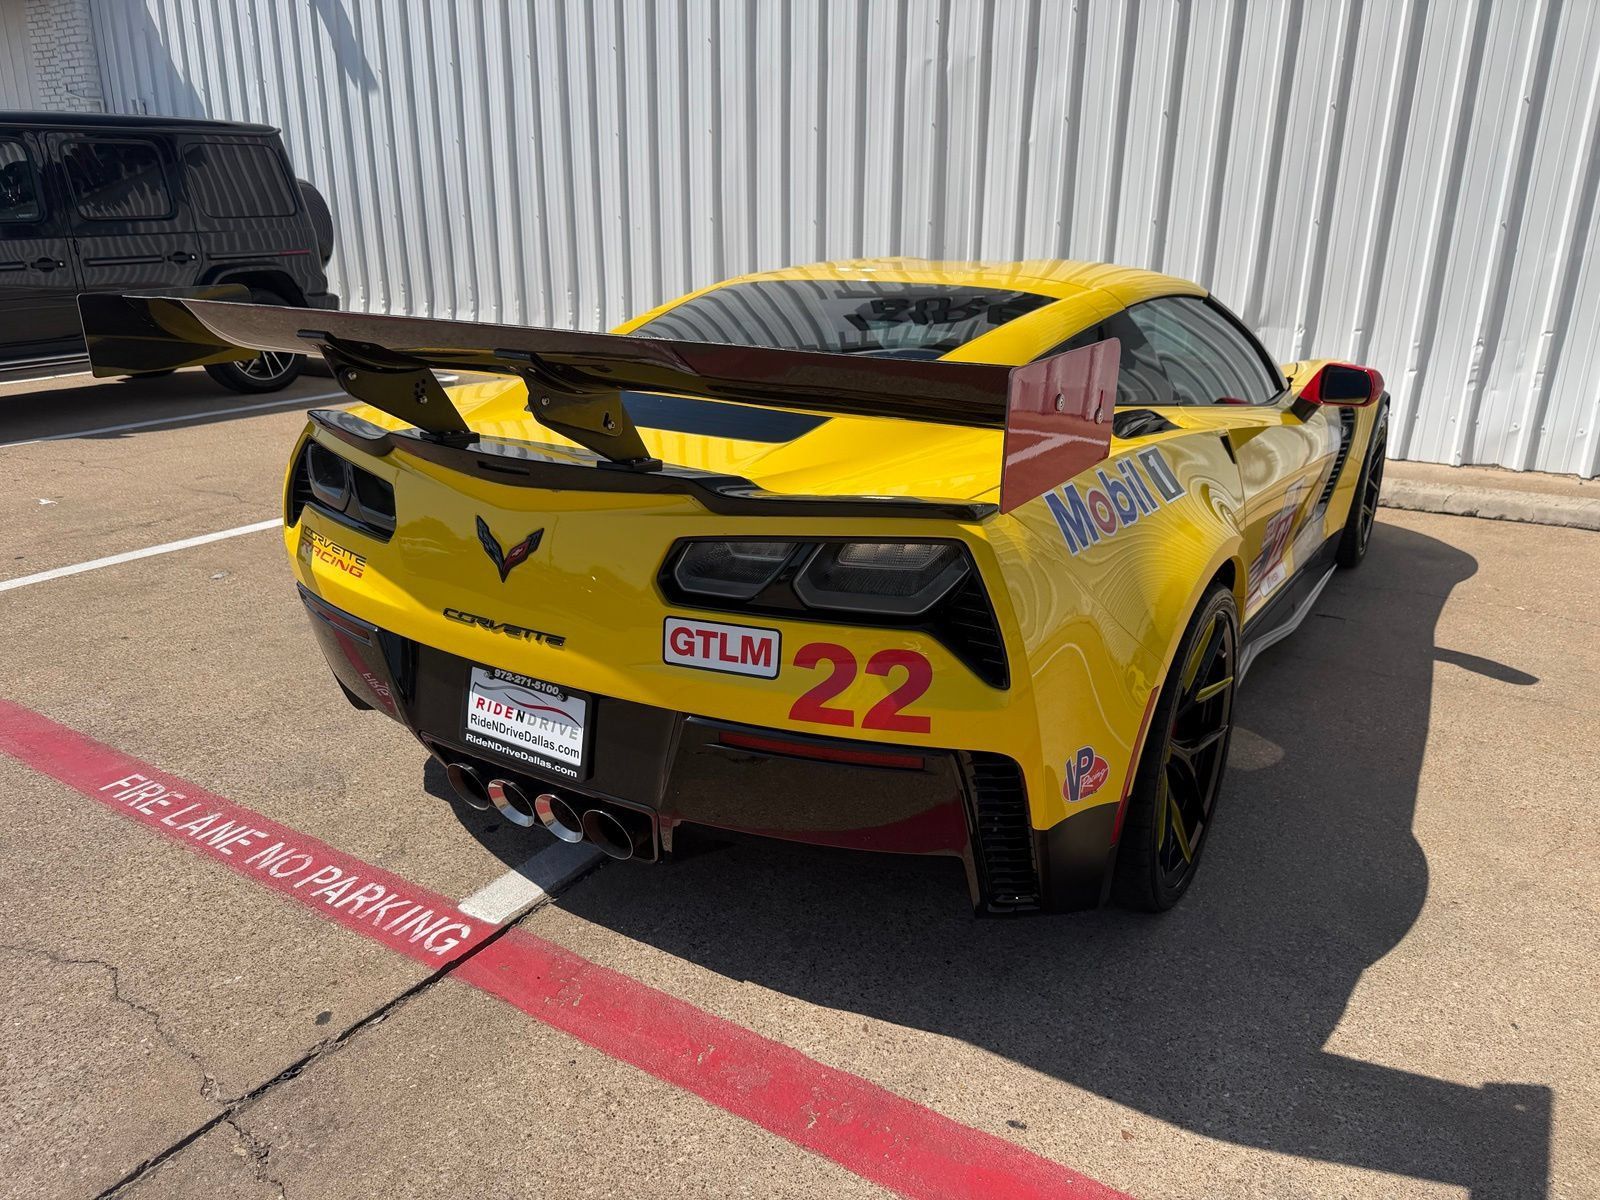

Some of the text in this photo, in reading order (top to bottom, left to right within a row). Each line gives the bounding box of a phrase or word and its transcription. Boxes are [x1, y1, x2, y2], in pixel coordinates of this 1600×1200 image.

[1042, 456, 1160, 556] Mobil
[302, 539, 364, 579] RACING
[304, 526, 367, 567] CORVETTE
[442, 607, 566, 647] CORVETTE
[669, 626, 773, 668] GTLM
[494, 669, 560, 695] 972-271-5100
[788, 642, 933, 734] 22
[465, 733, 578, 778] RideNDriveDallas.com
[470, 713, 580, 760] RideNDriveDallas.com
[1065, 745, 1095, 802] VP
[99, 773, 472, 956] FIRE LANE NO PARKING
